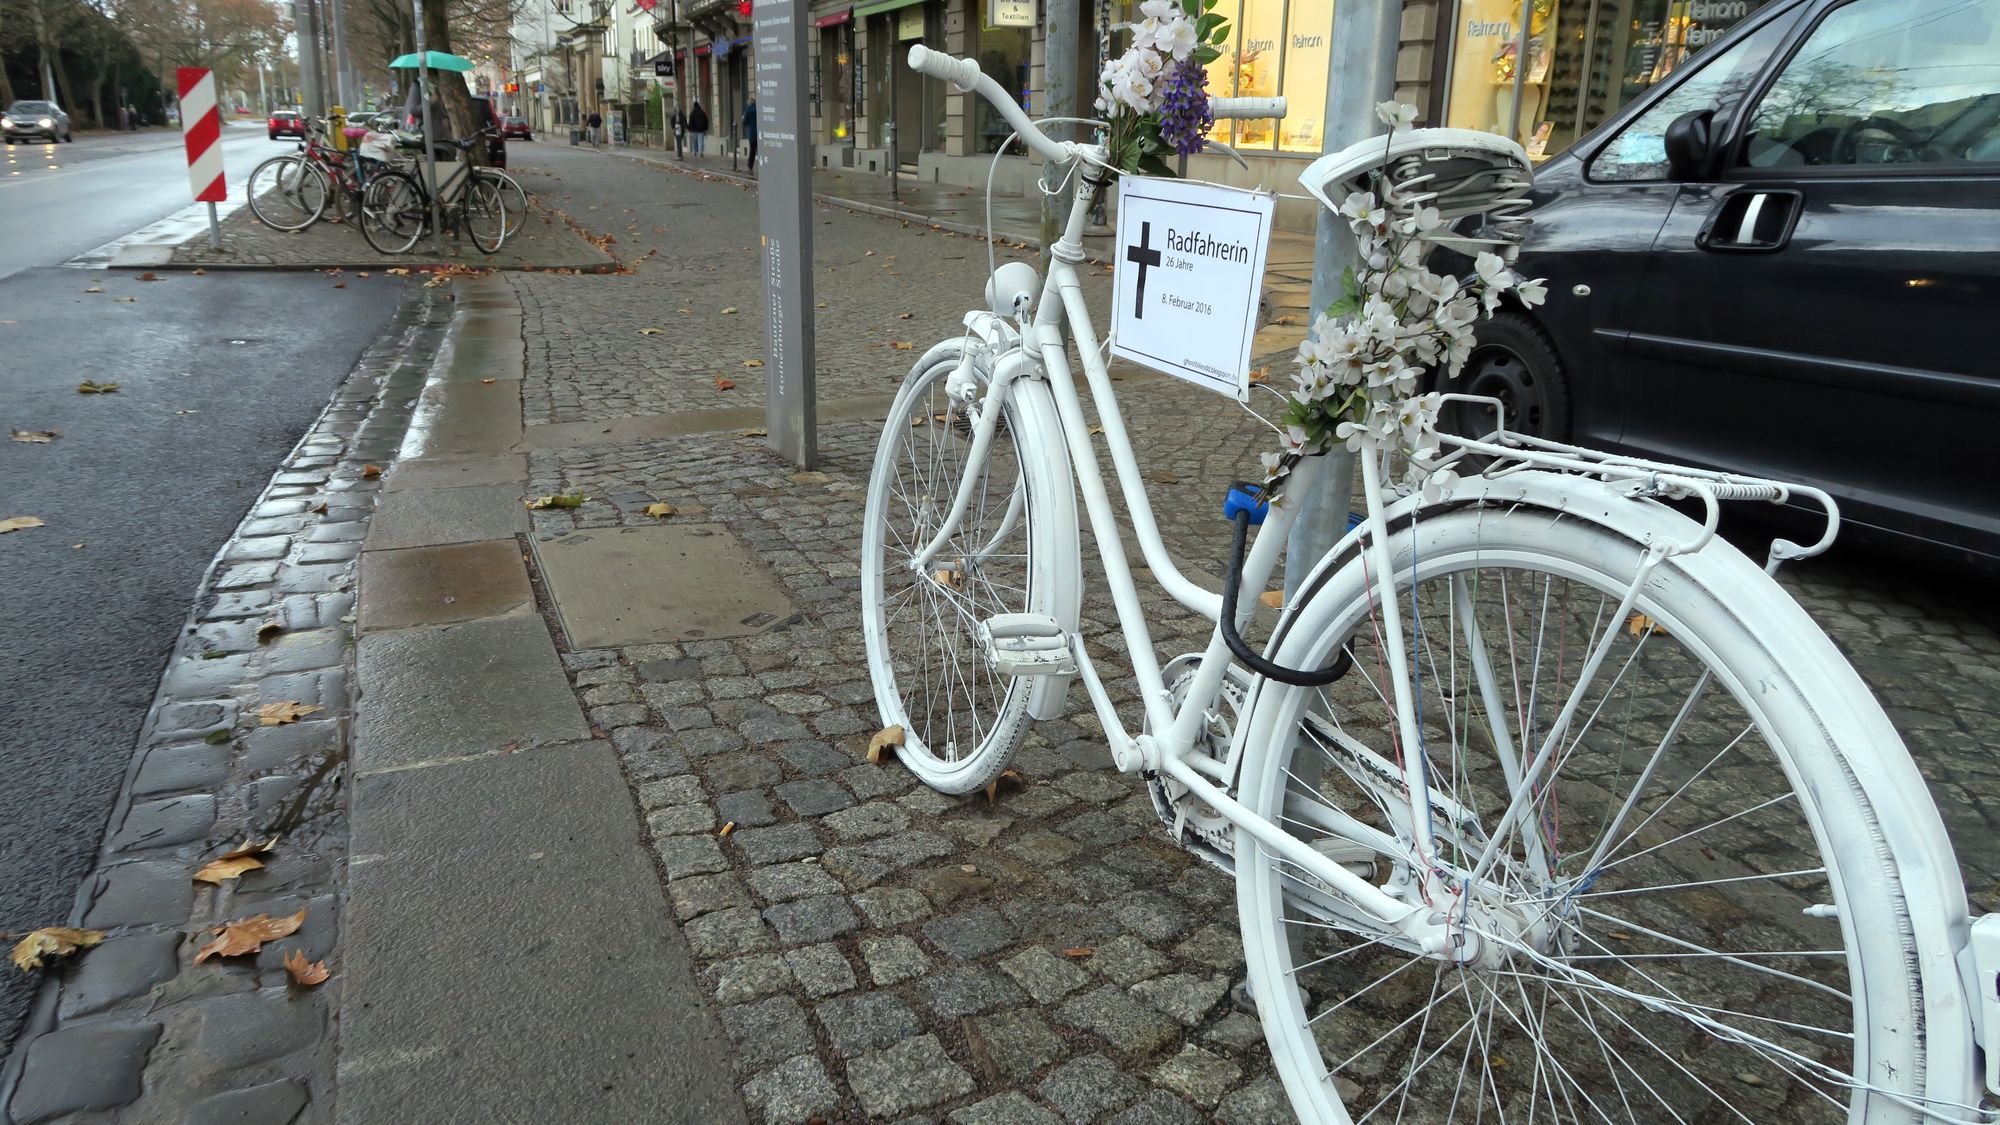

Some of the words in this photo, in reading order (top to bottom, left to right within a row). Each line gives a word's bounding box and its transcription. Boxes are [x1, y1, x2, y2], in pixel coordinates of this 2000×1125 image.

[657, 64, 671, 73] sky
[774, 239, 782, 289] Straße
[1166, 256, 1175, 268] 26
[1175, 257, 1194, 272] Jahre
[1167, 228, 1248, 264] Radfahrerin
[1161, 293, 1169, 305] 8.
[1169, 294, 1195, 312] Februar
[1195, 299, 1213, 316] 2016
[771, 291, 779, 359] Bautzner
[776, 293, 785, 396] Rothenburger
